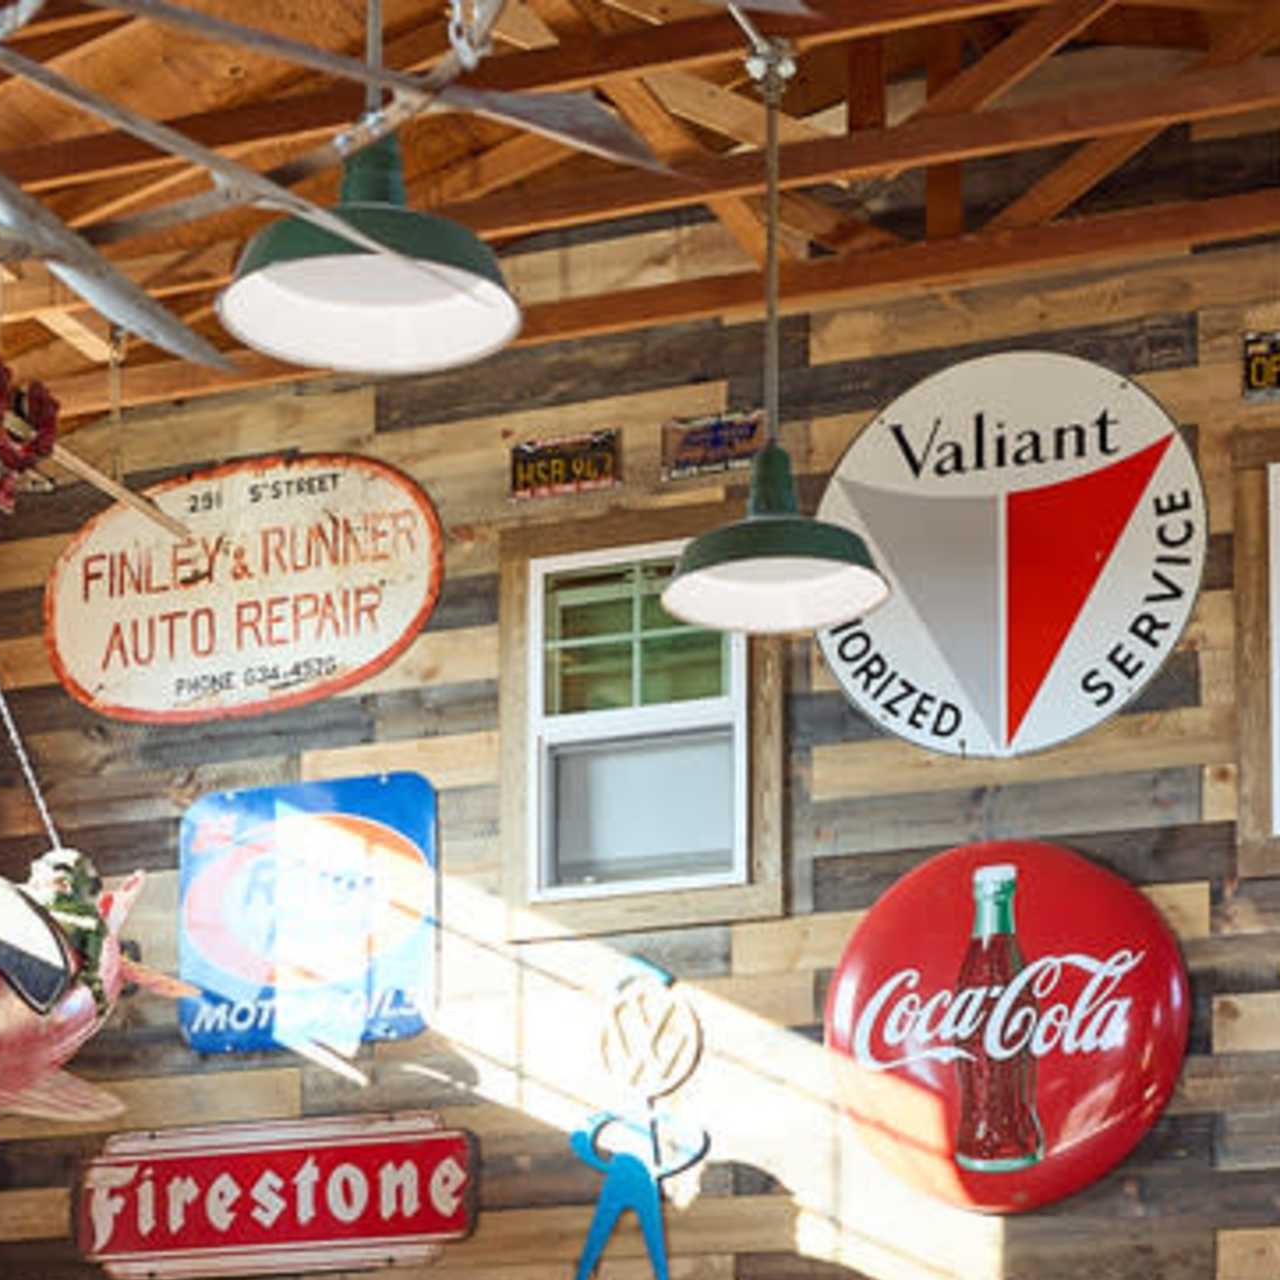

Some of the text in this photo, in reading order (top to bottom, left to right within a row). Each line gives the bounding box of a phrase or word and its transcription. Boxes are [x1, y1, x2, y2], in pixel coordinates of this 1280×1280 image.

[890, 408, 1122, 480] Valiant
[82, 535, 224, 603] FINLEY
[232, 546, 254, 581] &
[1078, 488, 1192, 708] SERVICE
[101, 575, 384, 672] AUTO REPAIR
[828, 617, 967, 739] ORIZED
[851, 949, 1146, 1071] Coca-Cola
[84, 1153, 469, 1253] Firestone
